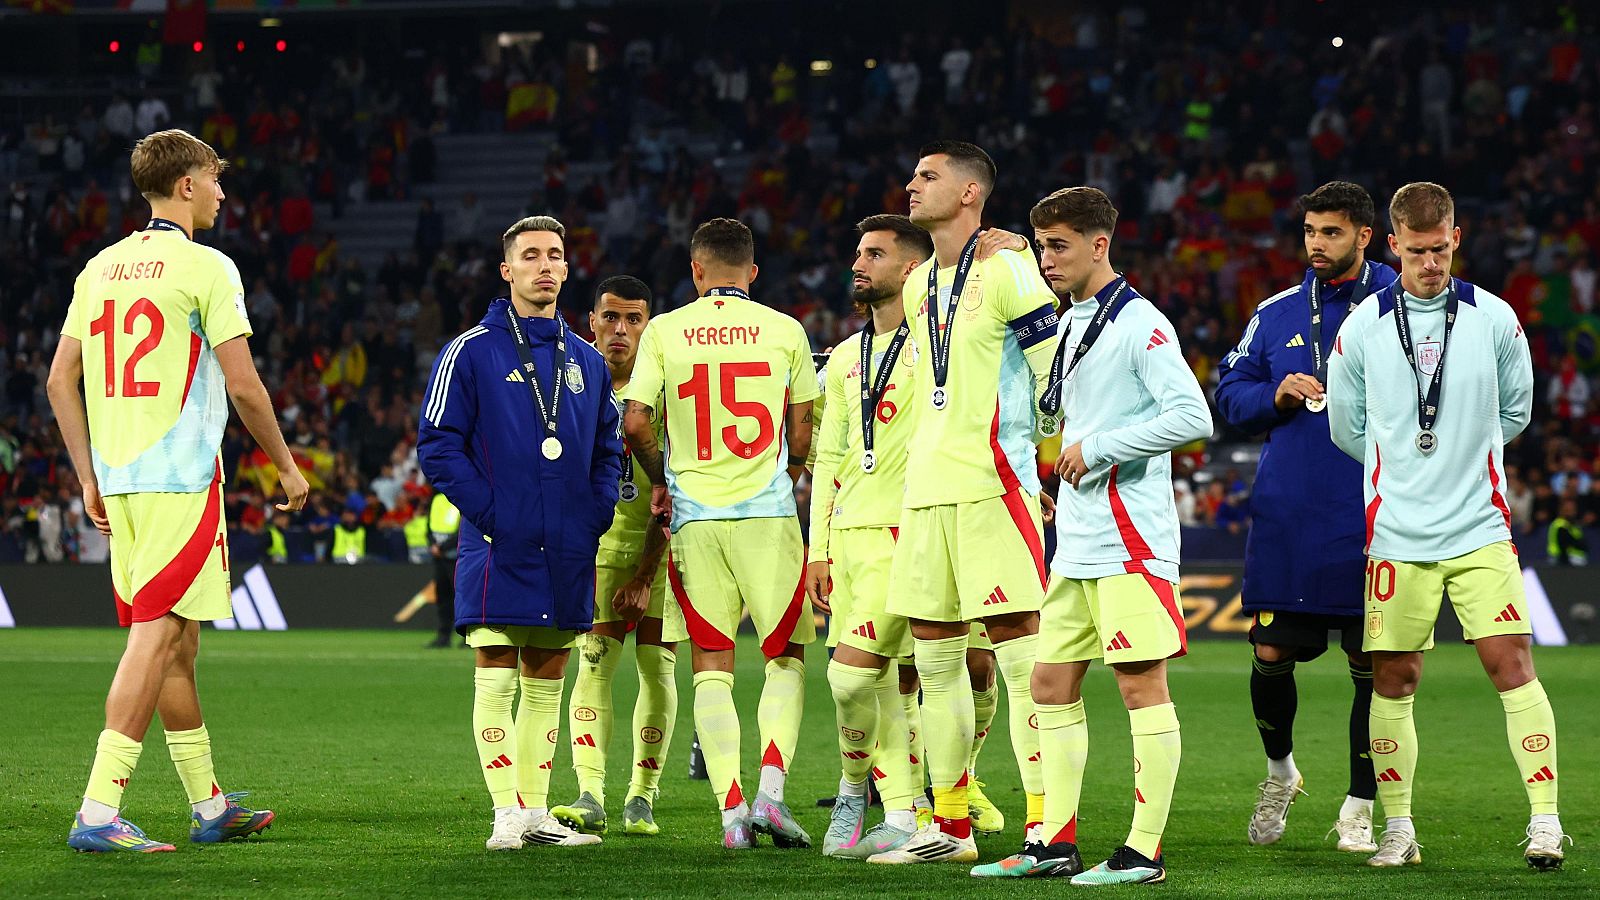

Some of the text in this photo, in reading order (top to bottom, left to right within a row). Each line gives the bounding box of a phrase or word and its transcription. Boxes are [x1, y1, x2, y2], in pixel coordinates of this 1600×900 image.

[102, 261, 164, 281] HUIJSEN
[960, 255, 969, 274] LEAGUE
[1107, 289, 1120, 306] NATIONS
[1096, 306, 1109, 326] LEAGUE
[514, 327, 524, 344] LEAGUE
[684, 326, 760, 346] YEREMY
[90, 297, 164, 397] 12
[876, 341, 899, 392] UEFA NATIONS LEAGUE
[535, 388, 544, 408] NATIONS
[870, 384, 897, 424] 6
[678, 362, 774, 460] 15
[216, 532, 231, 571] 1
[1366, 560, 1396, 602] 10
